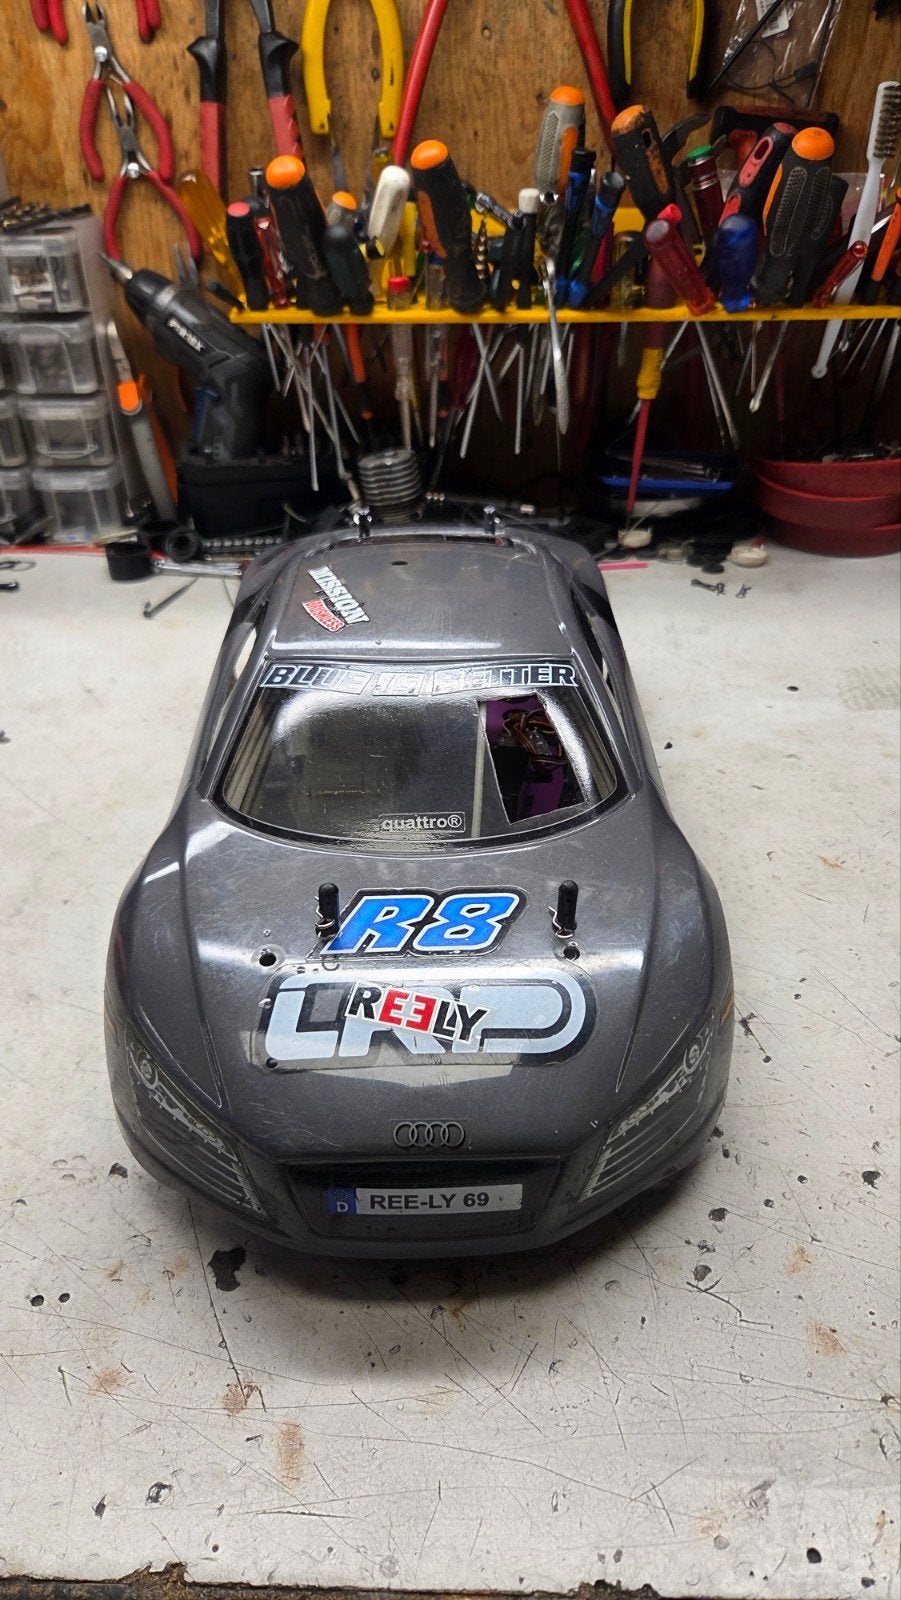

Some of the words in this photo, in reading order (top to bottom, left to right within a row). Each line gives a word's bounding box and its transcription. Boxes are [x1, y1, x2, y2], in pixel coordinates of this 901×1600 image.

[307, 565, 370, 625] MISSION
[260, 665, 374, 695] BLUE
[433, 664, 579, 696] BETTER
[320, 893, 520, 953] R8
[346, 983, 488, 1044] REELY
[336, 1201, 349, 1213] D
[369, 1194, 457, 1210] REE-LY
[463, 1192, 490, 1208] 69
